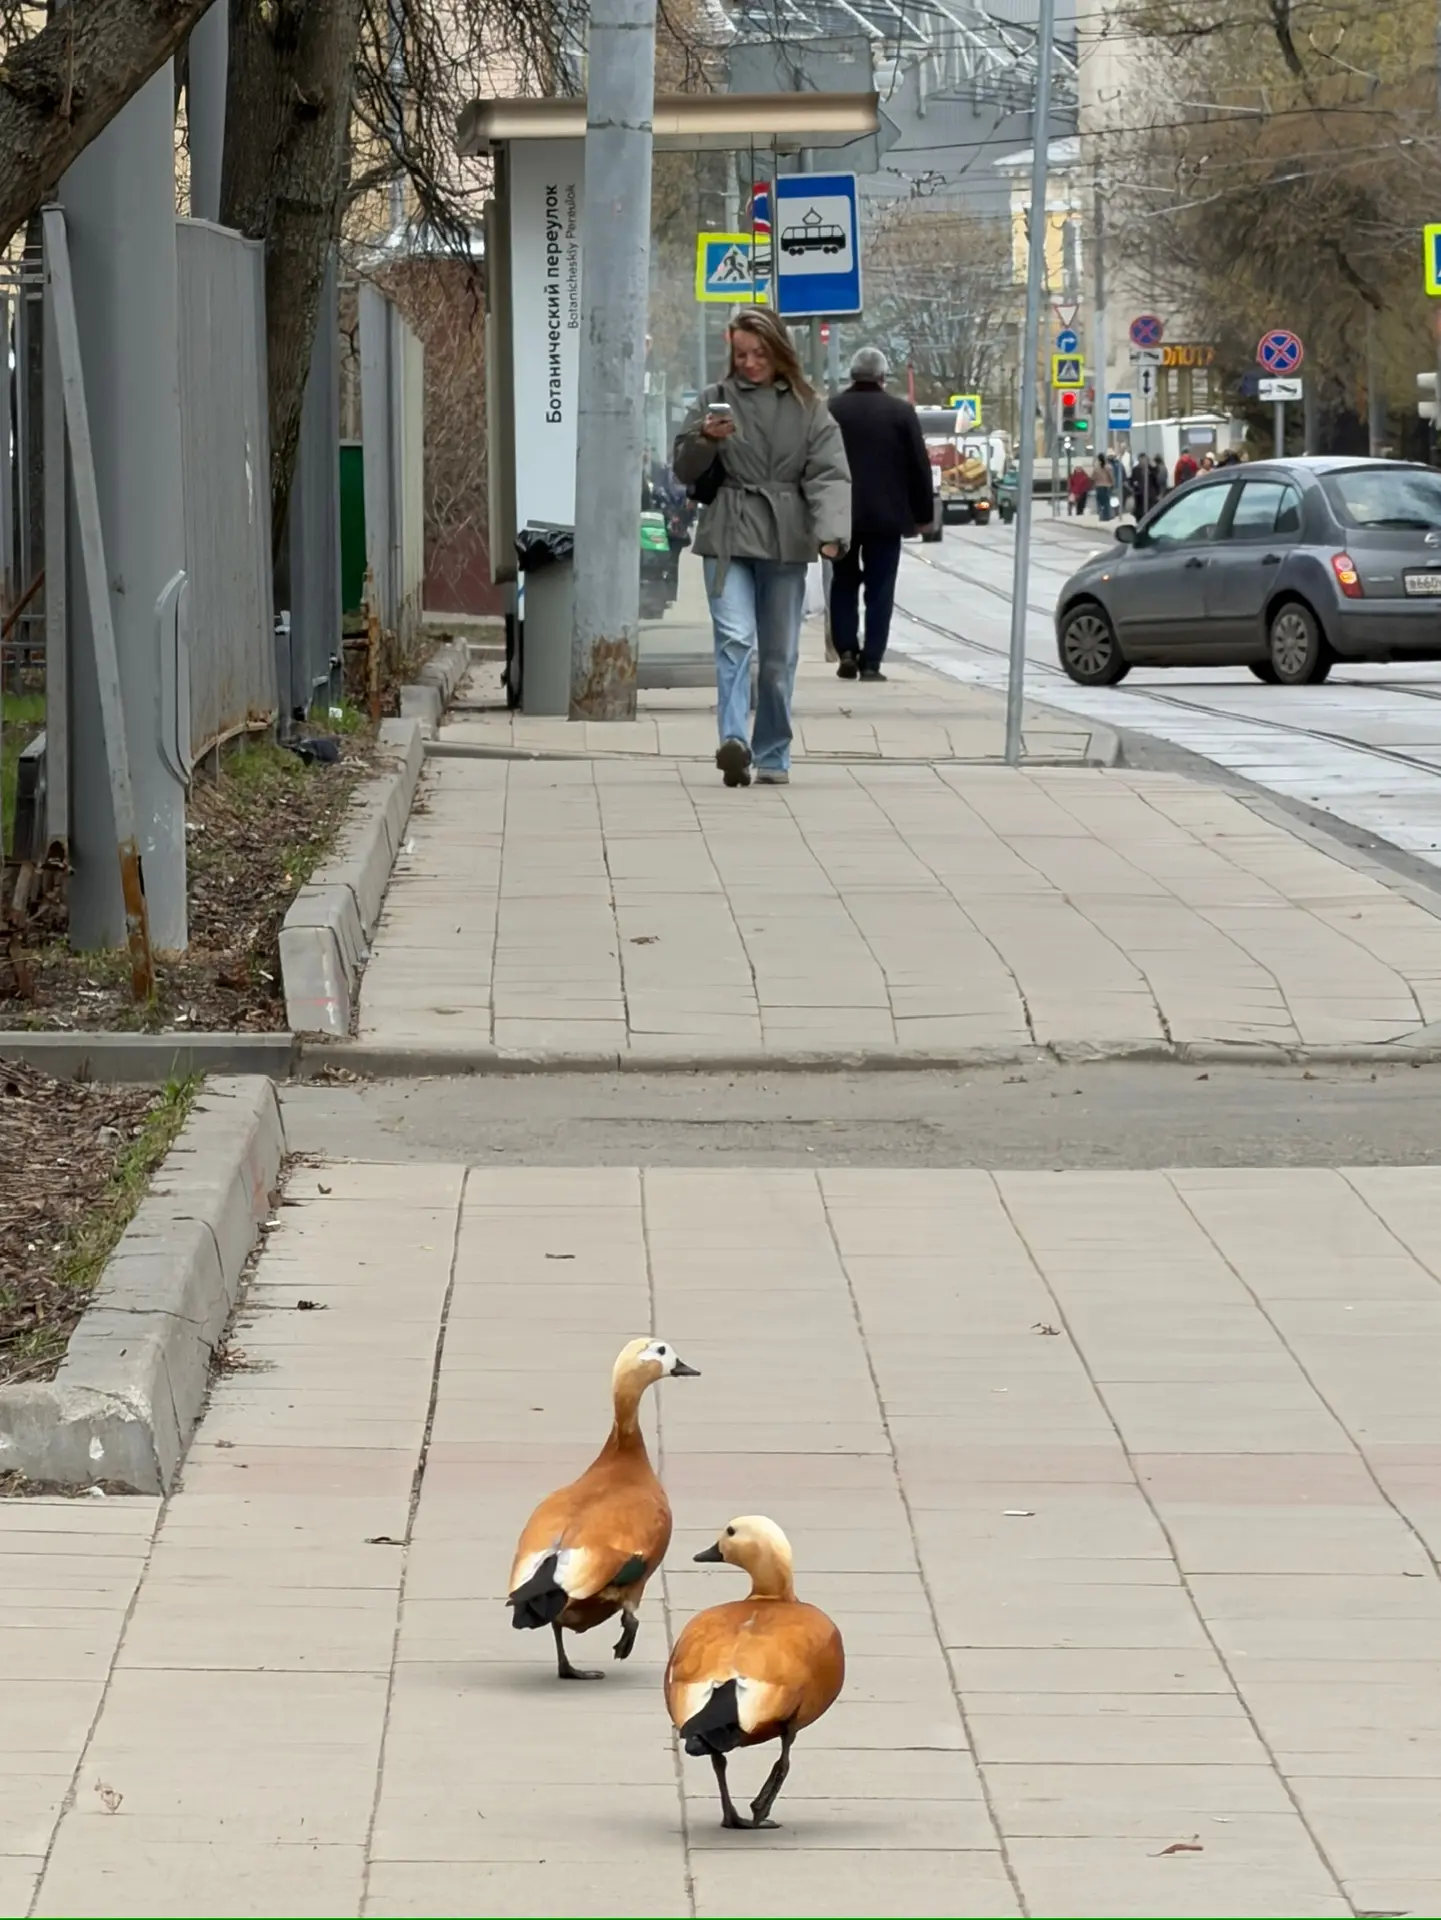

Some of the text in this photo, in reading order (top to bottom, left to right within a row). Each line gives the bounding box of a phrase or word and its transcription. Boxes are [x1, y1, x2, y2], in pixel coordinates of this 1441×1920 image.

[544, 184, 562, 424] Ботанический переулок
[564, 184, 579, 329] Botanicheskiy Pereulok
